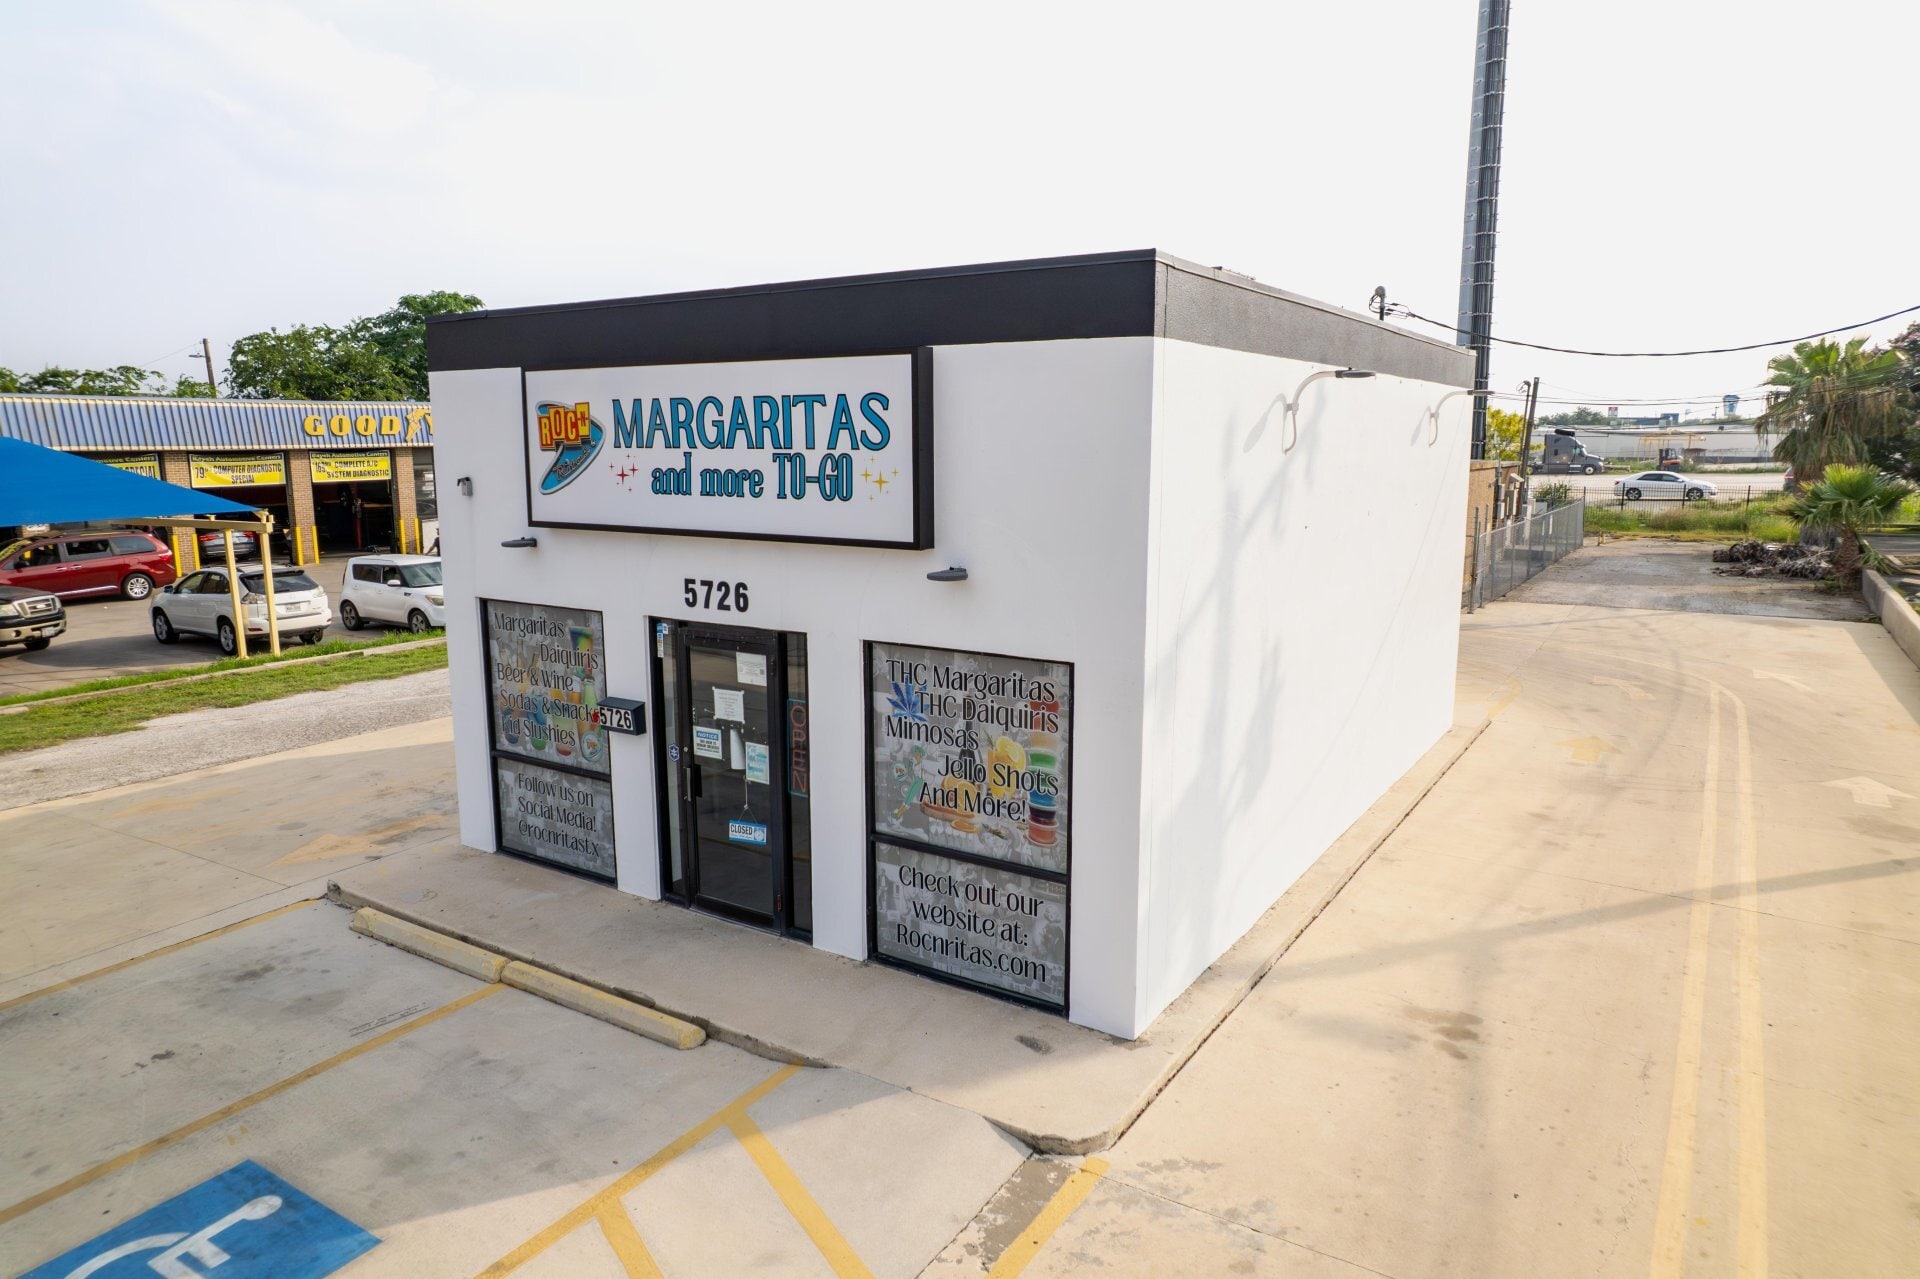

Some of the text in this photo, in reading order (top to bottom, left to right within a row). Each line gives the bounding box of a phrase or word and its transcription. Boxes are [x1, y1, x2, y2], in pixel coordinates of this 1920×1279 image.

[612, 392, 891, 451] MARGARITAS
[213, 464, 245, 474] COMPUTER
[246, 463, 282, 473] DIAGNOSTIC
[231, 474, 255, 484] SPECIAL
[327, 469, 389, 478] SYSTEM DIAGNOSTIC
[334, 460, 365, 468] COMPLETE
[651, 451, 853, 502] and more TO-GO
[684, 578, 749, 613] 5726
[494, 611, 565, 639] Margaritas
[540, 643, 599, 670] Daiquiris
[497, 662, 574, 692] Beer & Wine
[886, 660, 1055, 703] THC Margaritas
[500, 689, 538, 712] Sodas
[541, 698, 551, 715] &
[600, 706, 632, 729] 5726
[914, 691, 1059, 734] THC Daiquiris
[501, 717, 521, 735] Kid
[523, 719, 576, 747] Slushies
[697, 731, 718, 740] NOTICE
[790, 705, 808, 793] OPEN
[887, 715, 979, 750] Mimosas
[518, 773, 594, 808] Follow us on
[938, 755, 1059, 796] Jello Shots
[518, 796, 597, 832] Social Media!
[919, 782, 1027, 823] And More!
[518, 819, 600, 857] @rocnritastx
[731, 824, 753, 836] CLOSED
[899, 865, 1044, 917] Check out our
[1000, 920, 1028, 946] at:
[897, 923, 1046, 982] Rocnritas.com
